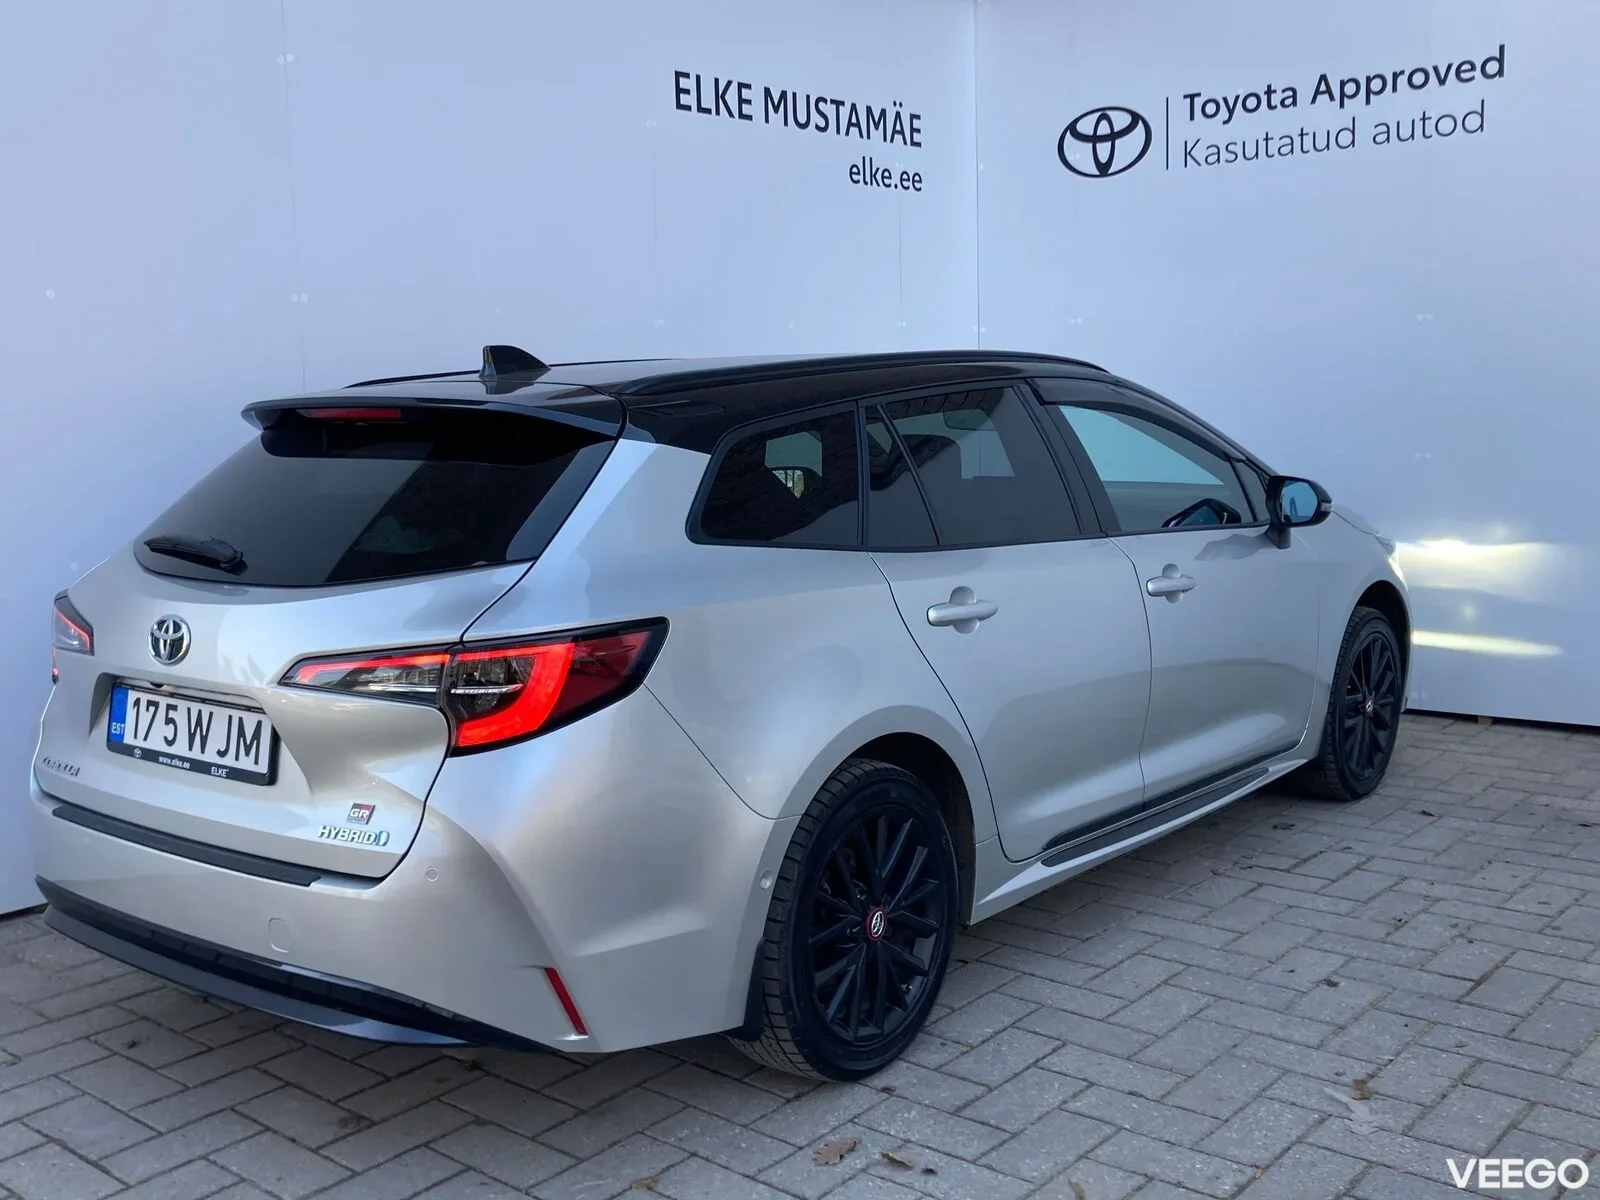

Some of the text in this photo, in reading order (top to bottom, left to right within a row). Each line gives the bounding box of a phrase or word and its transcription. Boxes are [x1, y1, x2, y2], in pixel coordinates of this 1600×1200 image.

[1183, 44, 1506, 125] Toyota Approved
[674, 69, 922, 149] ELKE MUSTAMÄE
[1183, 99, 1486, 169] Kasutatud autod
[849, 155, 922, 192] elke.ee
[111, 722, 125, 735] EST
[158, 756, 191, 770] www.elke.ee
[349, 808, 370, 819] GR
[317, 825, 377, 845] HYBRID
